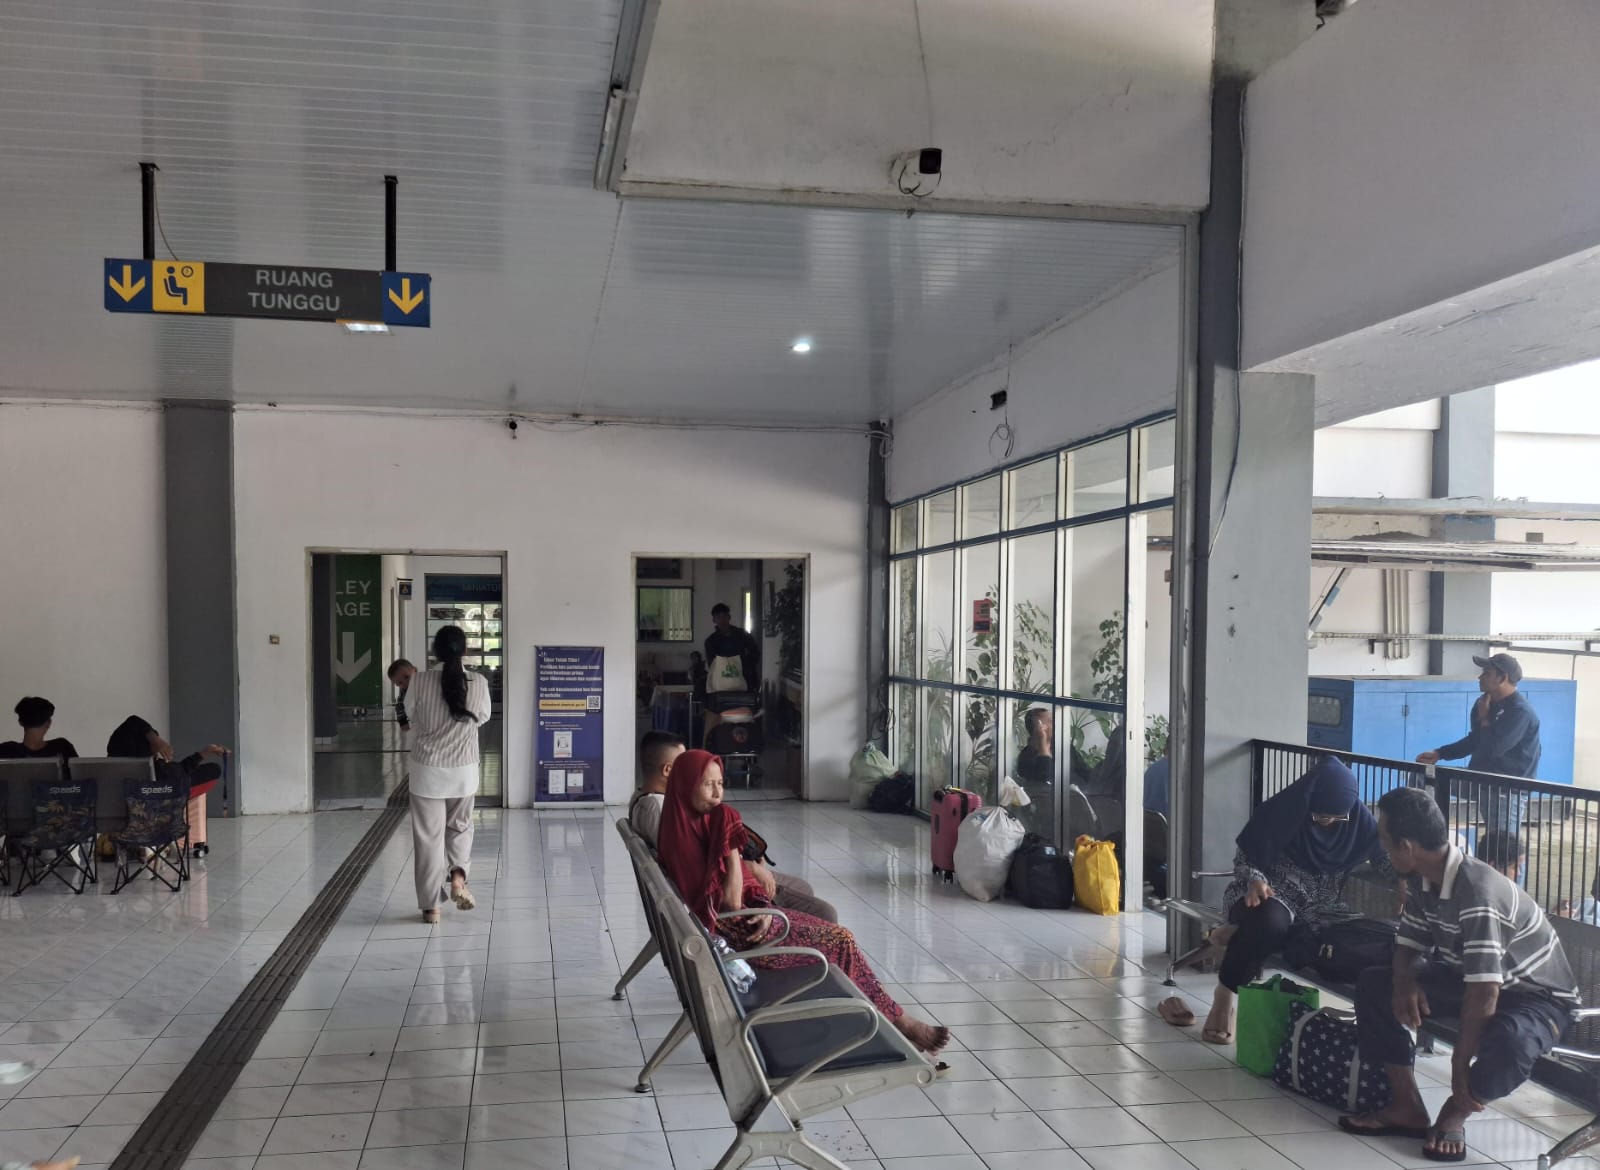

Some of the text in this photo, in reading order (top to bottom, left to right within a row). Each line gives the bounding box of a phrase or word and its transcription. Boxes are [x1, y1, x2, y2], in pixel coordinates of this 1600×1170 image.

[256, 269, 333, 288] RUANG
[247, 291, 341, 312] TUNGGU
[141, 784, 173, 796] speeds
